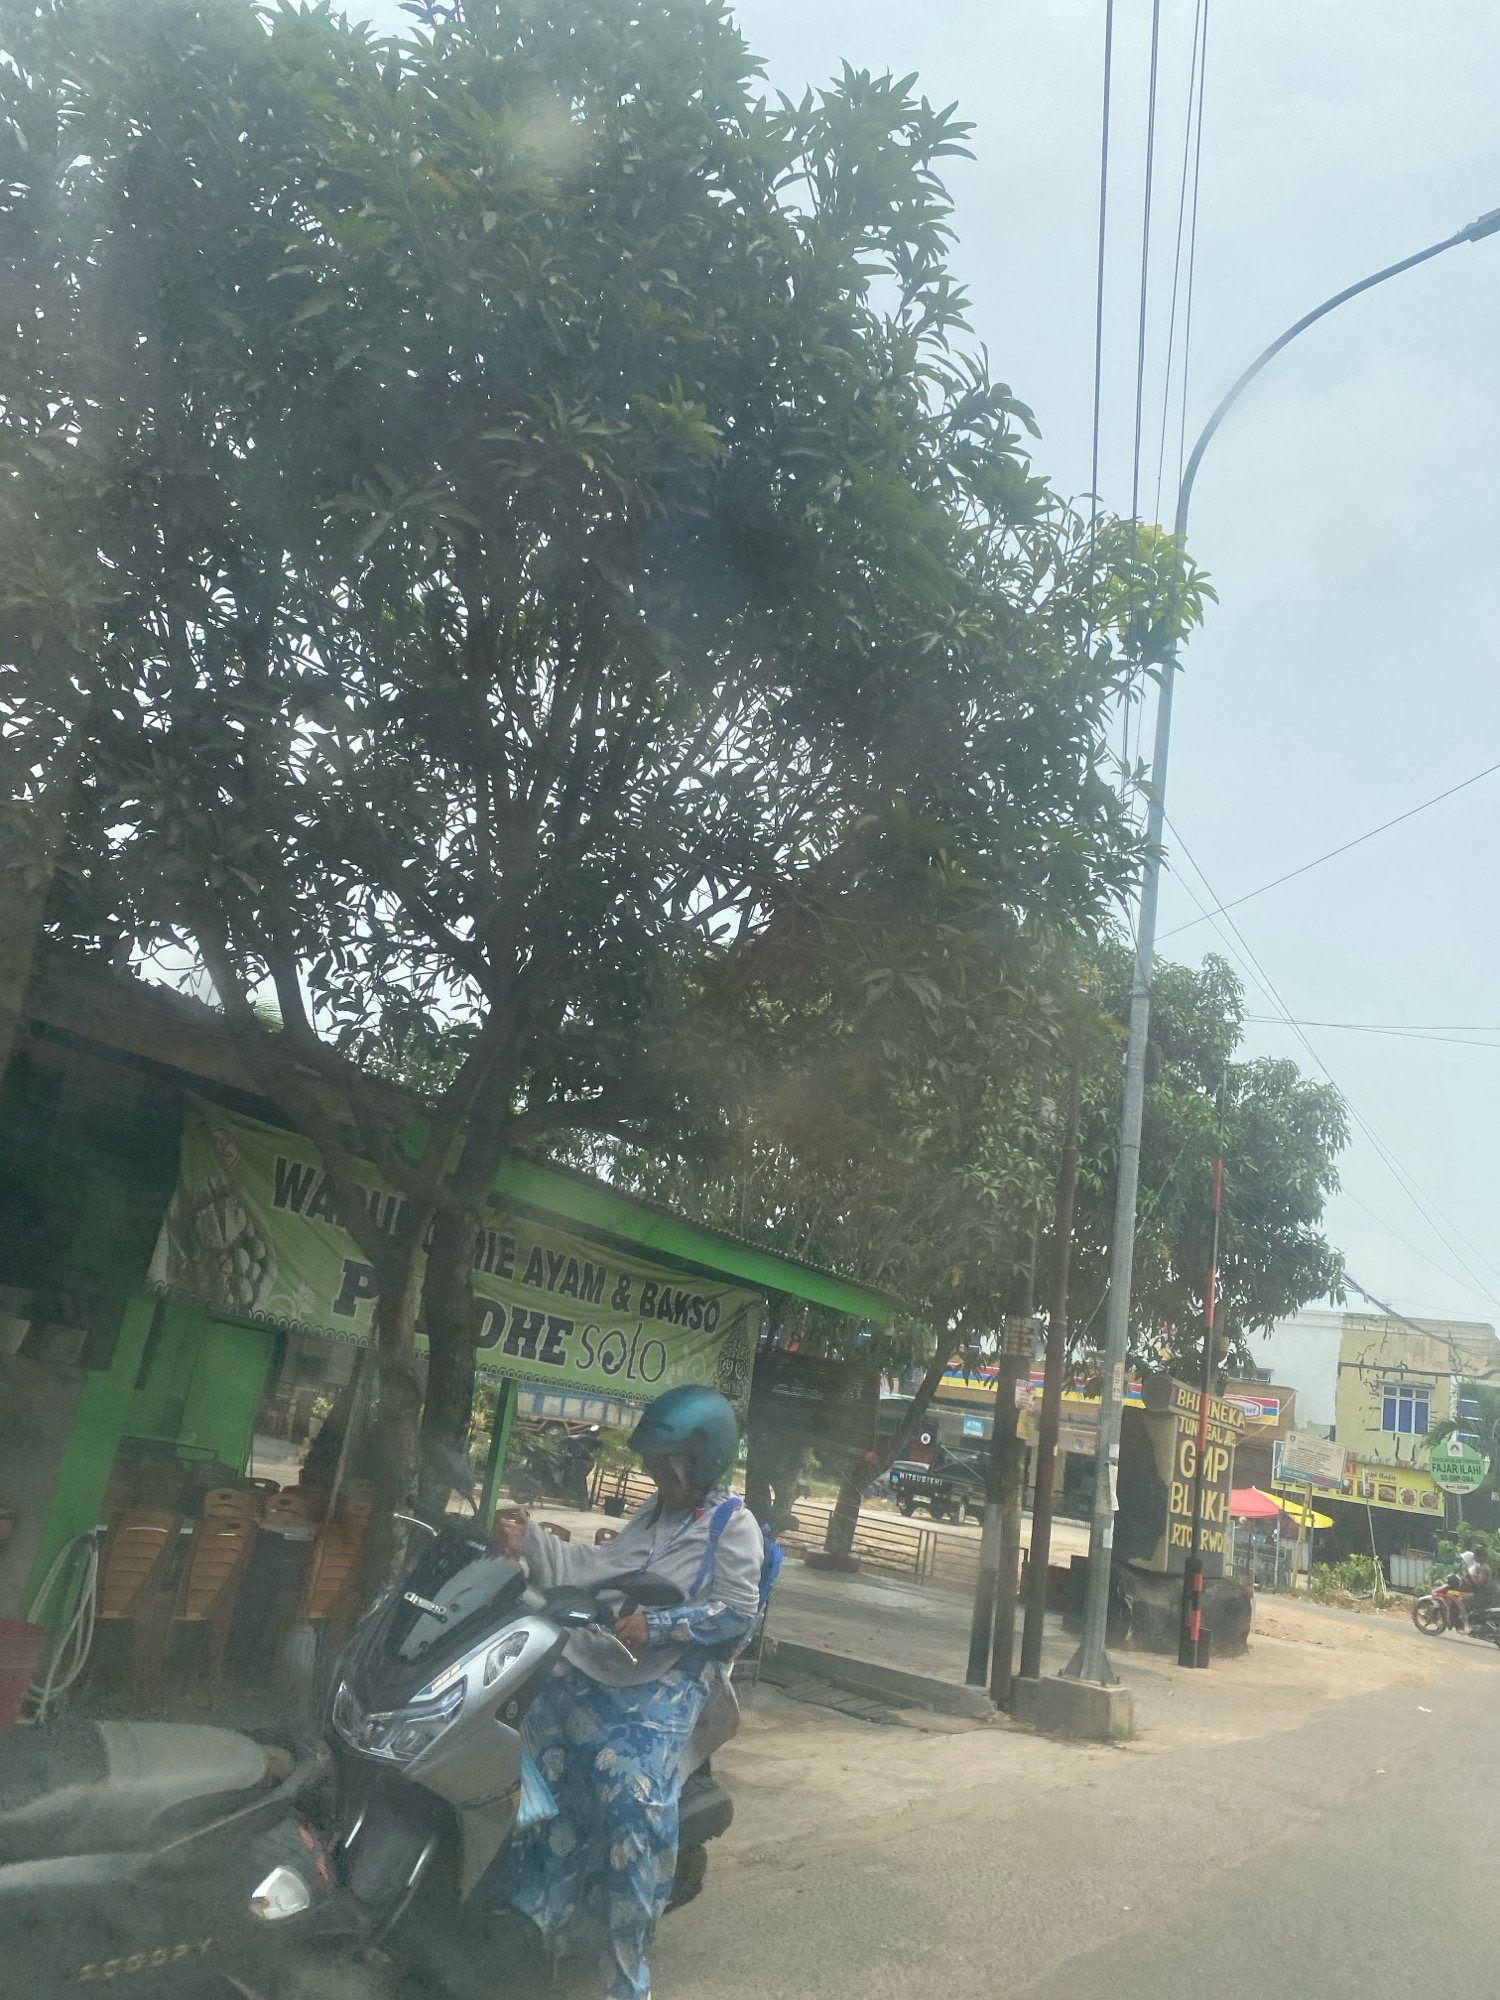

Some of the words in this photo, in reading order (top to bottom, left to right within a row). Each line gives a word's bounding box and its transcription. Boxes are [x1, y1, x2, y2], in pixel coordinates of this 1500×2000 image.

[521, 1246, 608, 1305] AYAM
[610, 1271, 633, 1313] &
[638, 1281, 722, 1334] BAKSO
[331, 1256, 576, 1368] PDHE
[1177, 1388, 1247, 1430] BHINEKA
[1179, 1416, 1223, 1445] TUNGAL
[900, 1472, 943, 1486] MITSUBISHI
[1432, 1463, 1459, 1474] FAJAR
[1460, 1465, 1482, 1476] ILAHI
